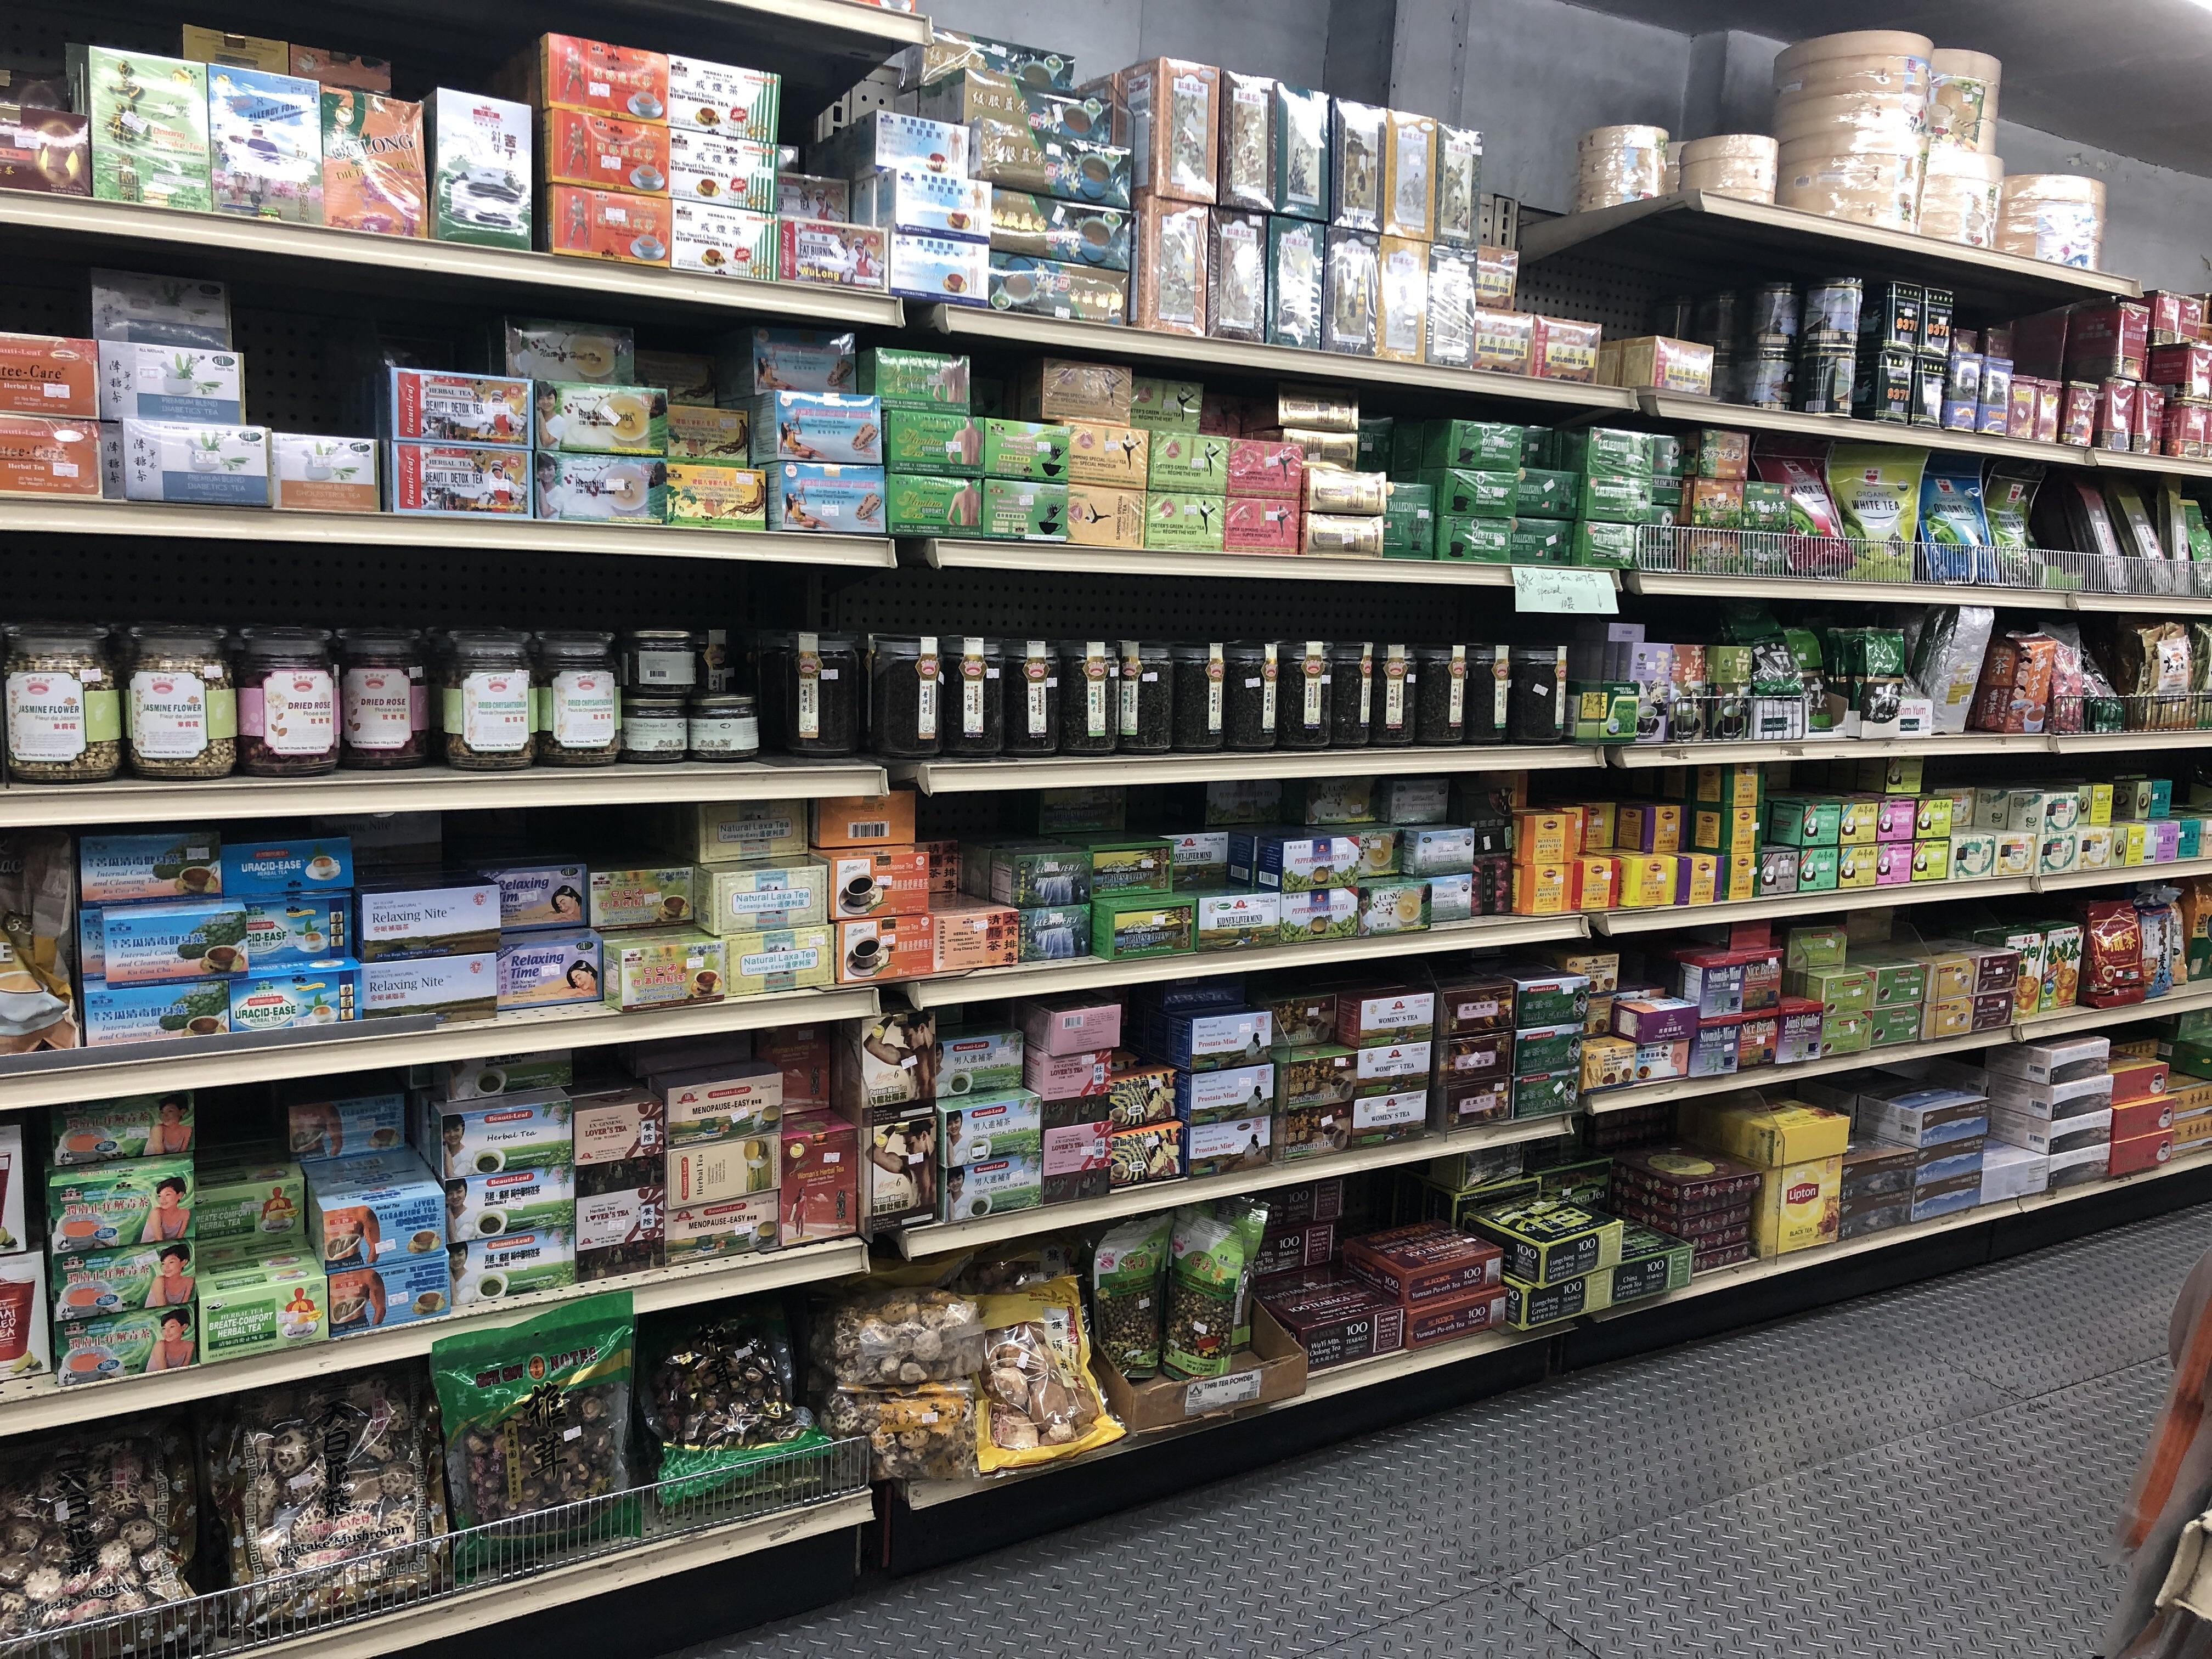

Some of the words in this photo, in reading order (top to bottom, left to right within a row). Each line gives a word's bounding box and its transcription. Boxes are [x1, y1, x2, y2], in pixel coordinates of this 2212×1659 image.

[800, 246, 810, 257] FAT
[800, 268, 839, 282] WuLong
[162, 406, 202, 415] DIABETICS
[407, 383, 415, 433] Beauti-leaf
[451, 402, 469, 413] DETOX
[472, 403, 483, 414] TEA
[1852, 499, 1880, 511] WHITE
[1883, 500, 1899, 511] TEA
[143, 703, 171, 712] JASMINE
[173, 703, 201, 712] FLOWER
[361, 698, 384, 707] DRIED
[19, 705, 47, 714] JASMINE
[49, 705, 79, 713] FLOWER
[1910, 705, 1926, 715] Yum
[241, 860, 301, 872] URACID-EASE
[736, 893, 768, 902] Natural
[771, 891, 791, 900] Laxa
[794, 890, 809, 899] Tea
[372, 910, 420, 924] Relaxing
[424, 907, 447, 918] Nite
[1292, 906, 1321, 915] PEPPERMINT
[1249, 915, 1262, 923] MIND
[133, 958, 170, 967] Cleansing
[511, 953, 564, 967] Relaxing
[511, 966, 539, 979] Time
[369, 979, 417, 993] Relaxing
[421, 977, 443, 988] Nite
[235, 1005, 296, 1019] URACID-EASE
[1742, 1023, 1756, 1033] Nice
[1757, 1020, 1775, 1030] Breath
[1074, 1065, 1084, 1074] TEA
[712, 1087, 748, 1097] Beauti-Leaf
[1198, 1091, 1238, 1102] Prostata-Mind
[693, 1099, 750, 1115] MENOPAUSE-EASY
[489, 1111, 529, 1122] Beauti-Leaf
[487, 1132, 518, 1142] Herbal
[585, 1127, 613, 1137] LOVER'S
[798, 1169, 819, 1180] Woman's
[820, 1167, 836, 1176] Herbal
[491, 1174, 531, 1185] Beauti-Leaf
[1788, 1185, 1817, 1201] Lipton
[689, 1215, 745, 1231] MENOPAUSE-EASY
[1647, 1260, 1664, 1272] 100
[1623, 1274, 1638, 1283] China
[1564, 1281, 1581, 1294] 100
[1617, 1281, 1633, 1291] Green
[1532, 1297, 1559, 1308] Lungching
[1469, 1307, 1486, 1317] 100
[1532, 1306, 1548, 1317] Green
[209, 1312, 273, 1331] BREATE-COMFORT
[217, 1325, 246, 1339] HERBAL
[248, 1322, 262, 1333] TEA
[1346, 1322, 1369, 1335] 100
[1416, 1329, 1436, 1340] Yunnan
[1437, 1324, 1454, 1335] Pu-erh
[1346, 1334, 1368, 1344] TEABAGS
[1331, 1345, 1341, 1353] Tea
[550, 1346, 598, 1370] NOTES
[1230, 1374, 1254, 1385] POWDER
[334, 1526, 405, 1547] Mushroom
